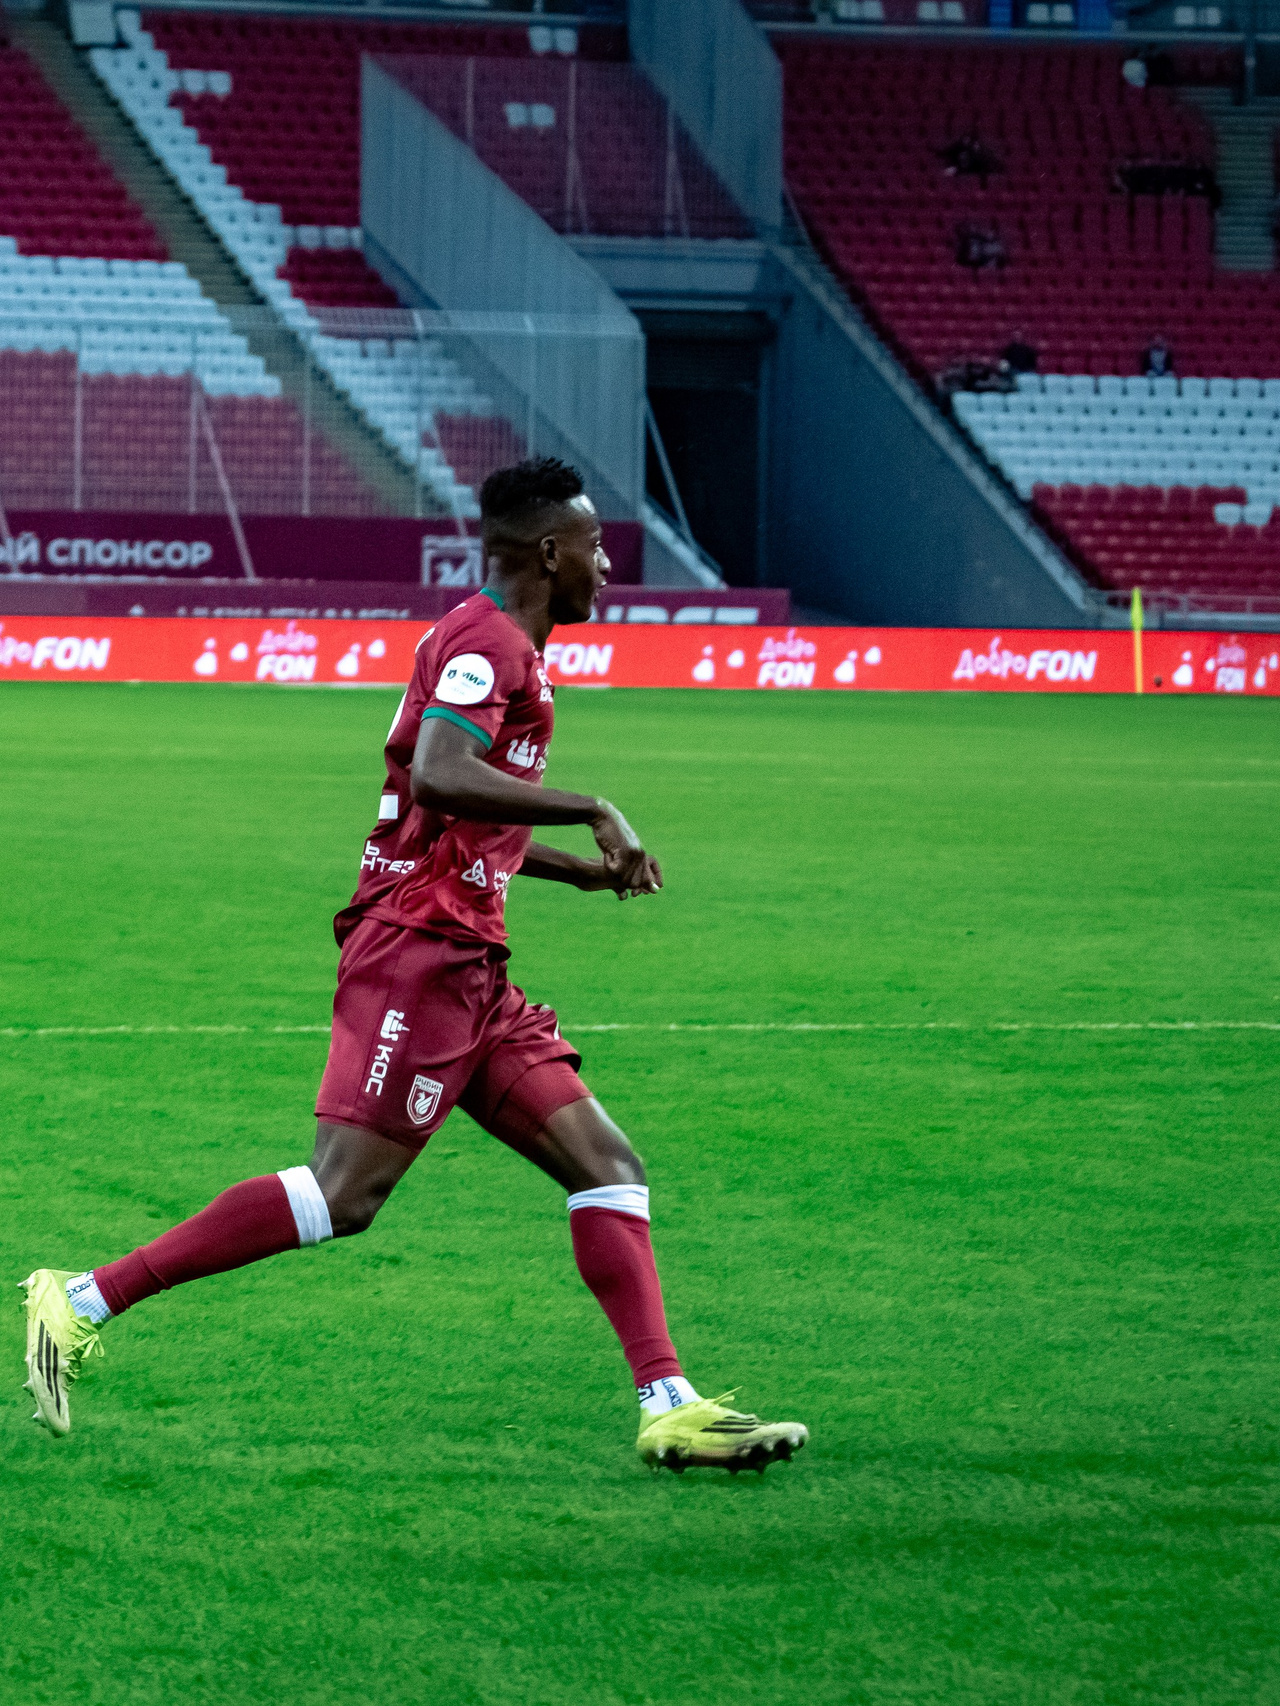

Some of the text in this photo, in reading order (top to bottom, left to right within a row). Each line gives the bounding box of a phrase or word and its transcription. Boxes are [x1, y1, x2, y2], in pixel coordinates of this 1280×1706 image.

[47, 538, 212, 568] СПОНСОР
[256, 654, 317, 680] FON
[757, 661, 816, 687] FON
